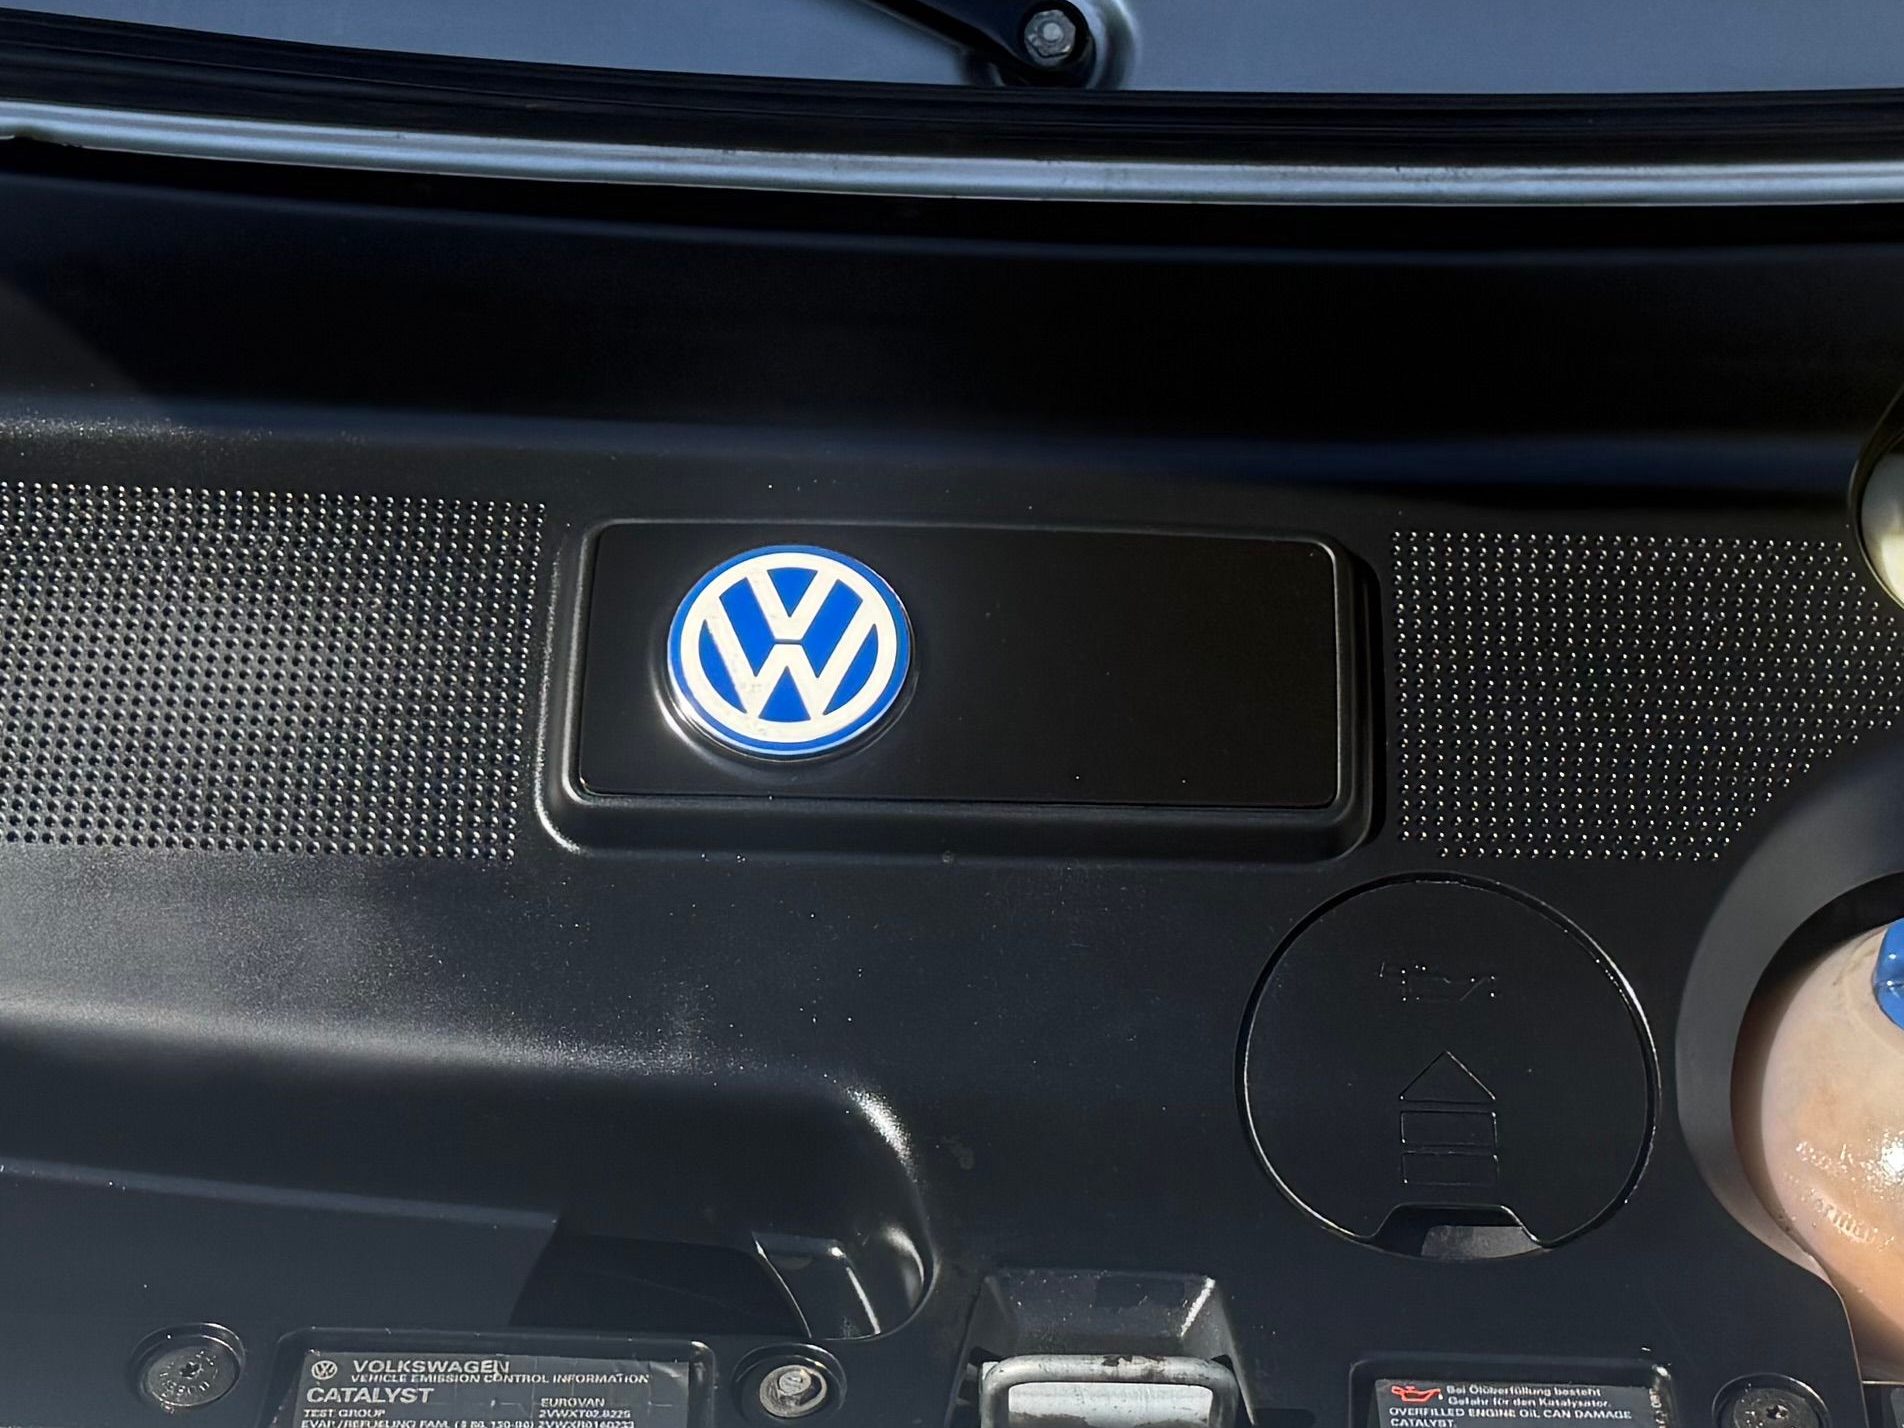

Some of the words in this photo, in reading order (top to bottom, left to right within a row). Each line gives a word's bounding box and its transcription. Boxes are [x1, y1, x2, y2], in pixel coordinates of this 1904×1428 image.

[353, 1359, 510, 1374] VOLKSWAGEN
[351, 1374, 407, 1383] VEHICLE
[411, 1374, 480, 1383] EMISSION
[484, 1374, 549, 1383] CONTROL
[553, 1373, 649, 1384] INFORMATION
[306, 1387, 434, 1403] CATALYST
[541, 1398, 605, 1407] EUROVAN
[1389, 1407, 1465, 1417] OVERFILLED
[1468, 1408, 1516, 1418] ENGINE
[1519, 1409, 1540, 1418] OIL
[1543, 1409, 1571, 1419] CAN
[1575, 1409, 1632, 1419] DAMAGE
